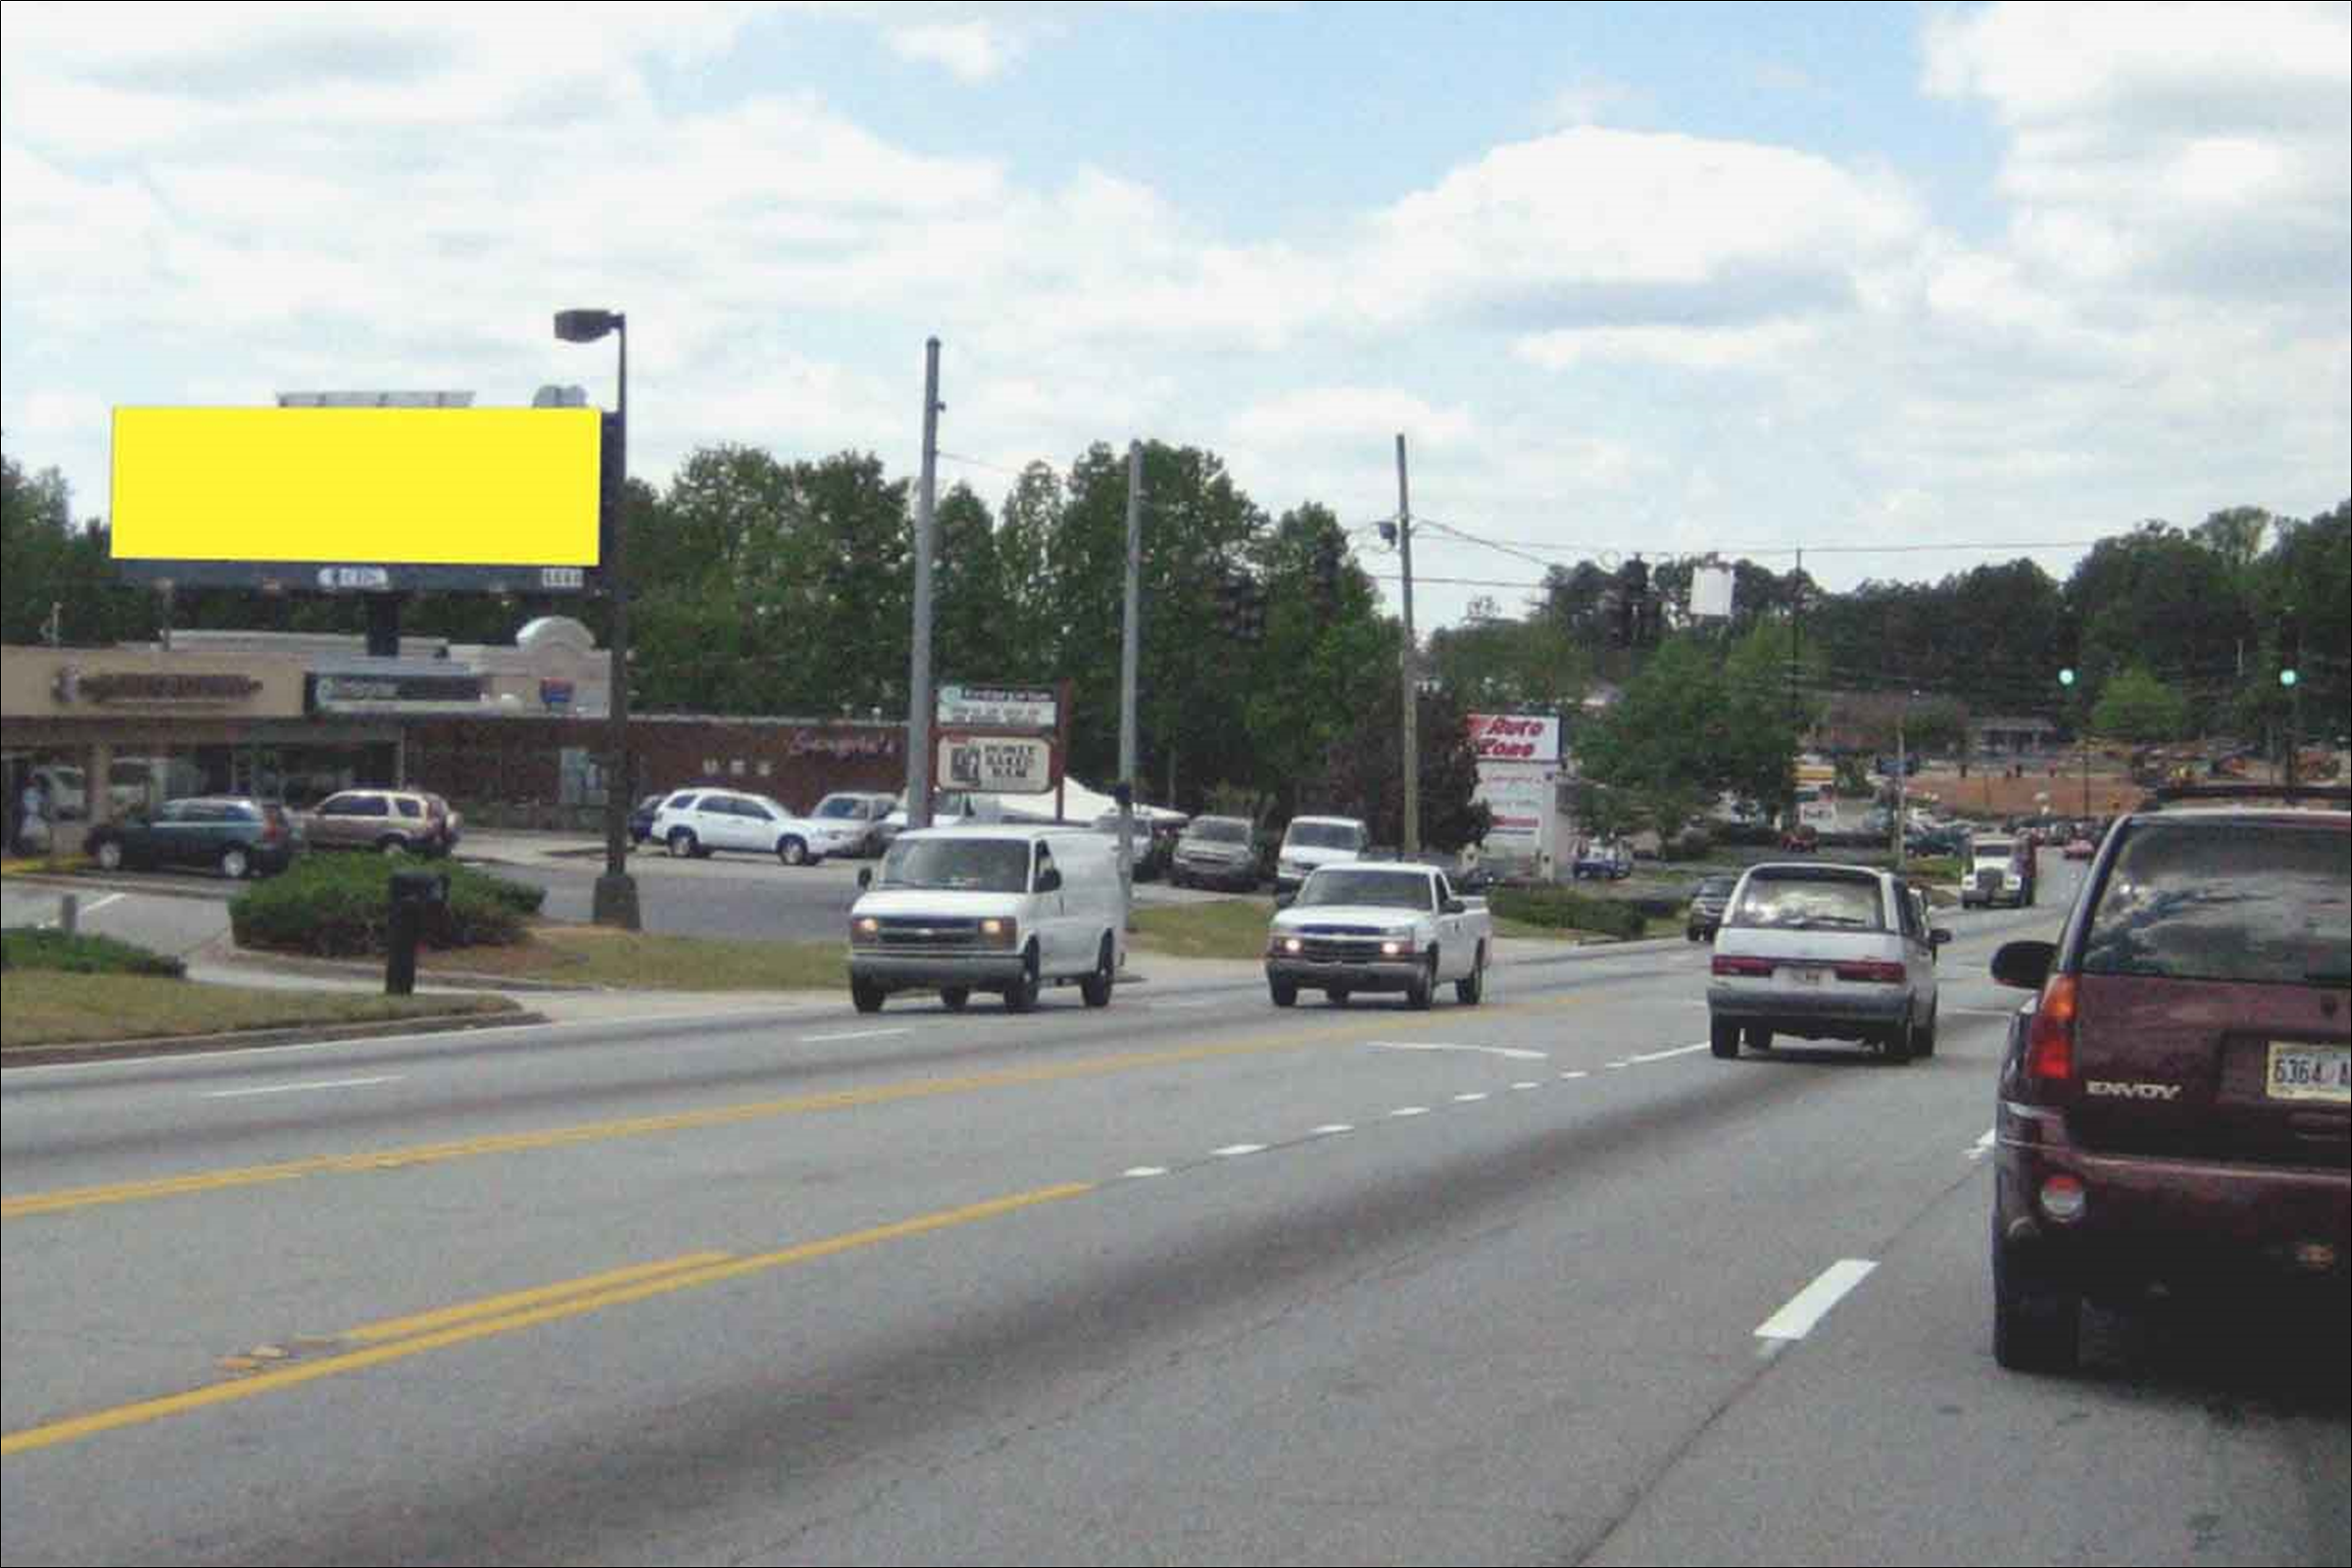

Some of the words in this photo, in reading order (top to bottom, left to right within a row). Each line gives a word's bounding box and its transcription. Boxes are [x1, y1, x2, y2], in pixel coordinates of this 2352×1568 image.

[1487, 716, 1544, 736] Auto
[1479, 739, 1536, 758] Zone
[2086, 1081, 2181, 1100] ENVOY
